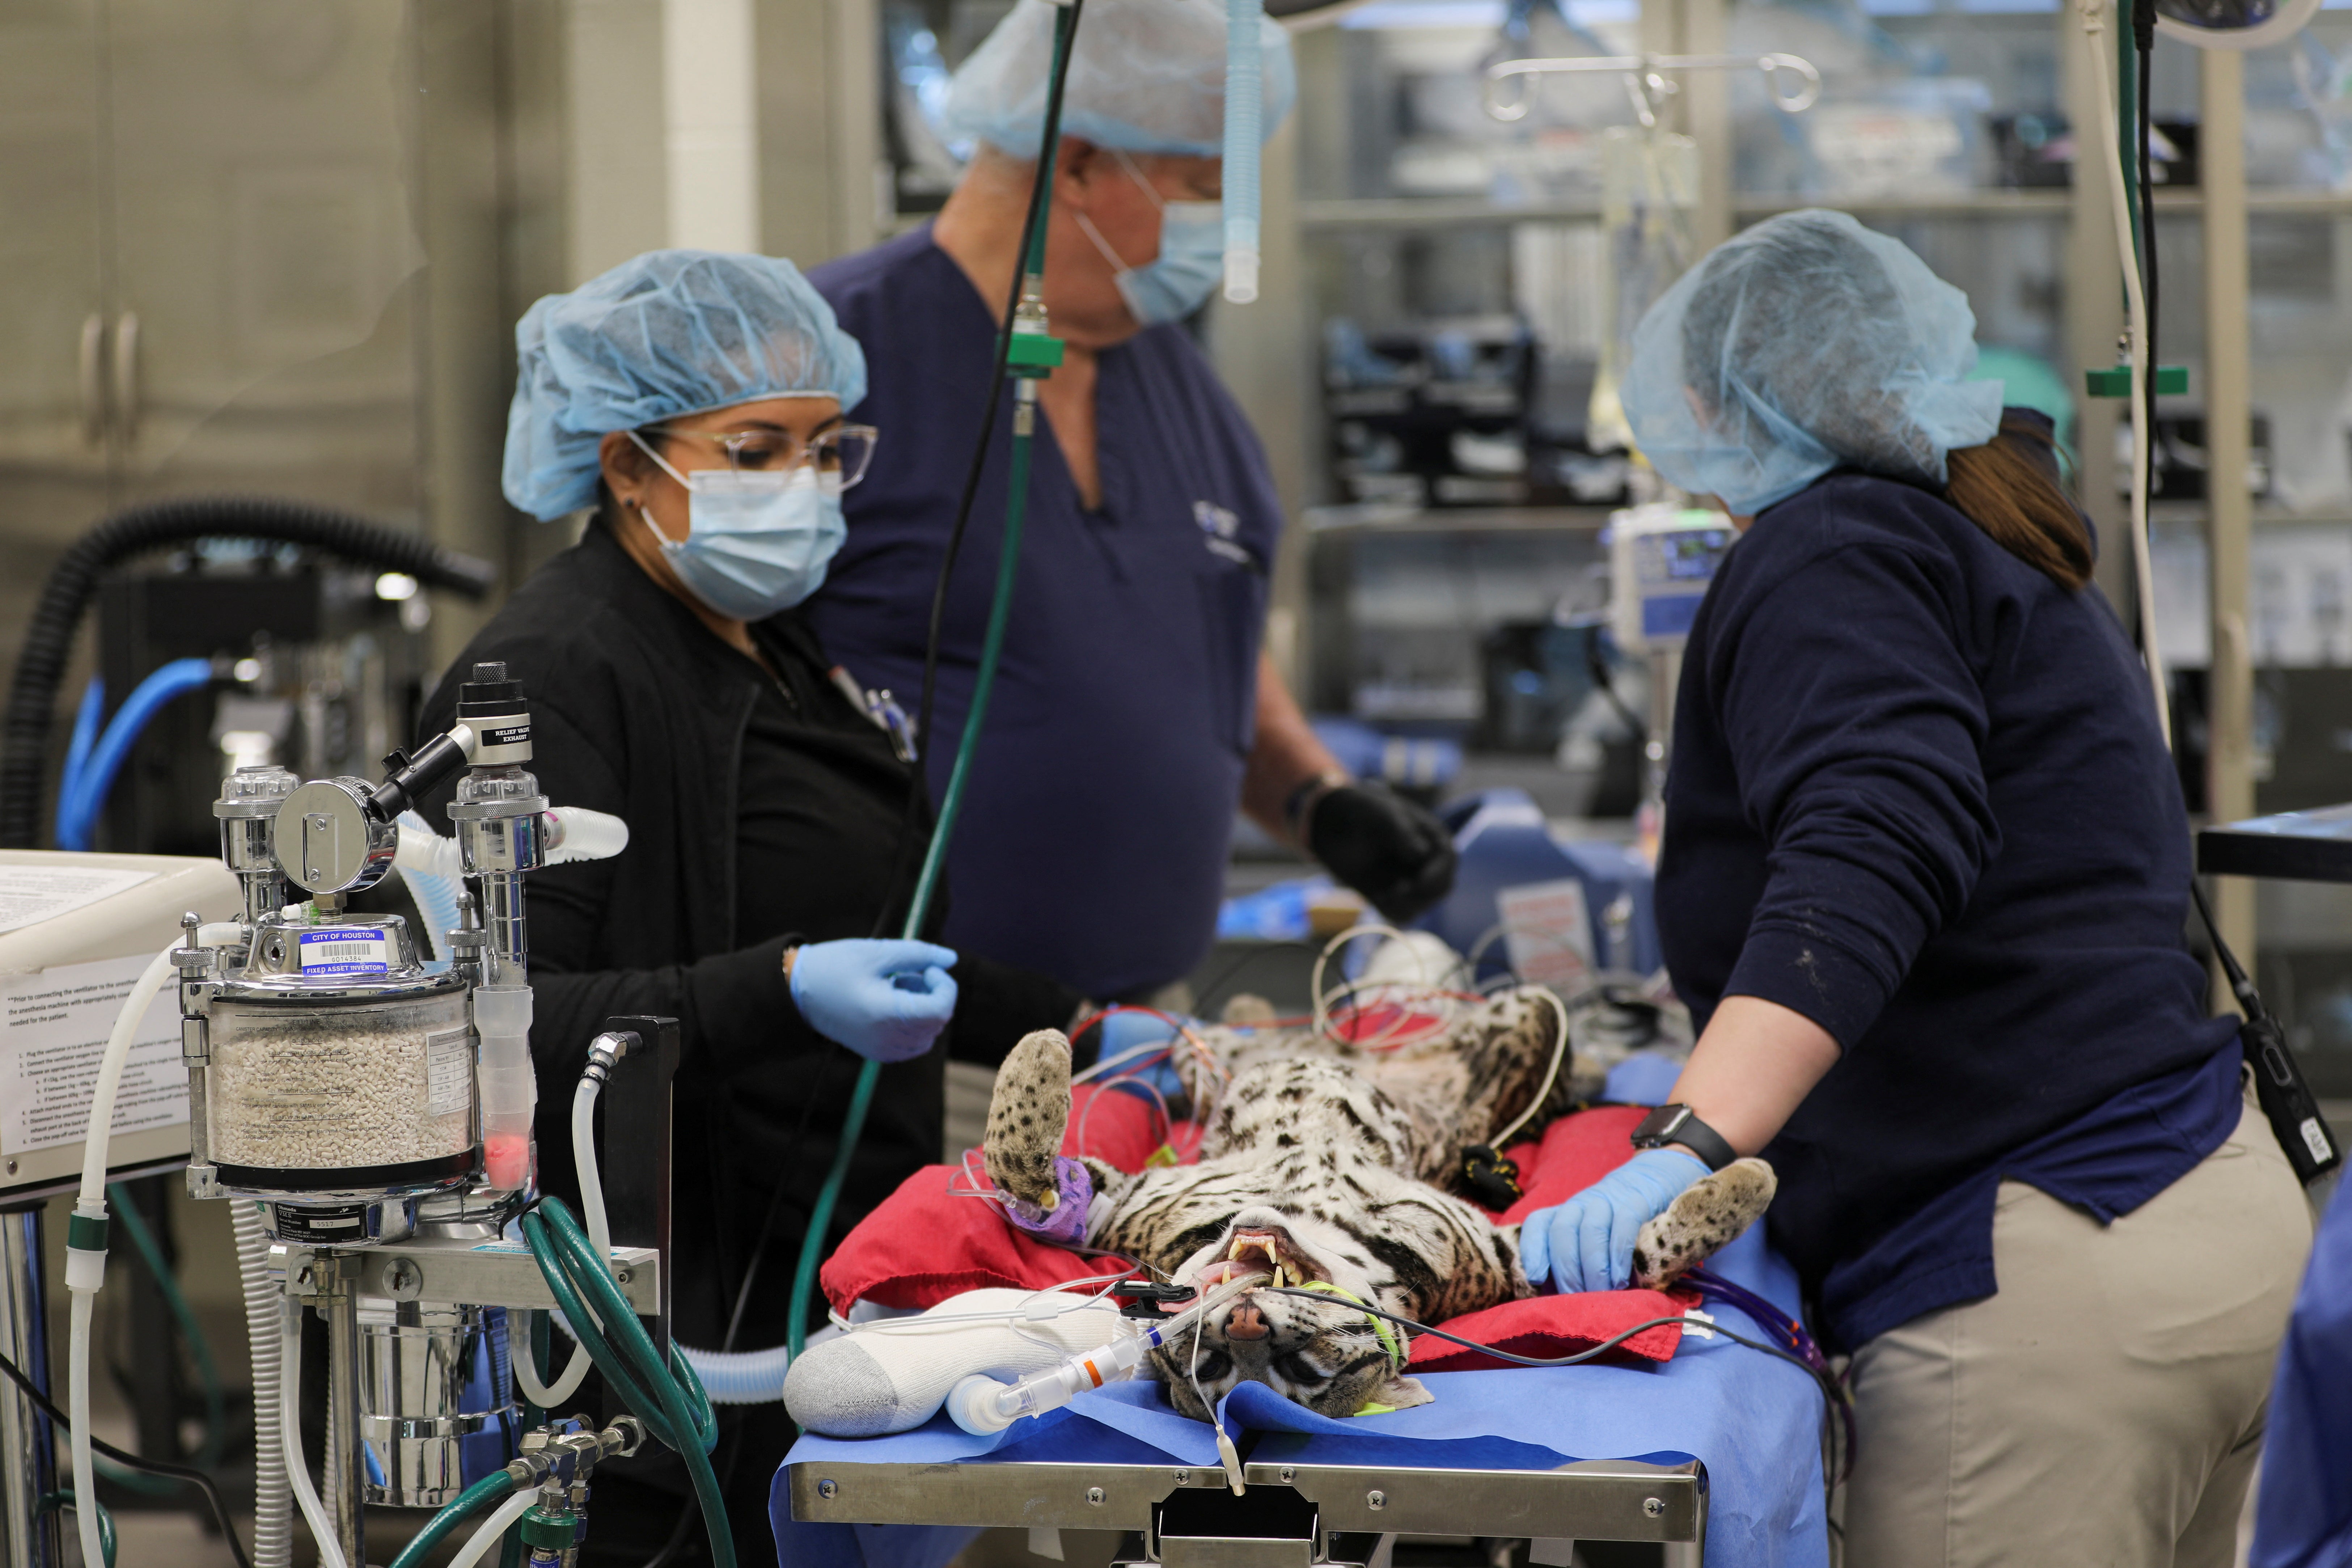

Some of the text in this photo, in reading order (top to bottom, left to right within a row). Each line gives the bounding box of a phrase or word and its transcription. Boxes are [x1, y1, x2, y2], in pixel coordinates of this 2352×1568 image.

[34, 991, 62, 999] connecting
[73, 985, 97, 994] ventilator
[18, 1005, 46, 1014] anesthesia
[83, 994, 116, 1006] appropriately
[9, 1018, 29, 1027] needed
